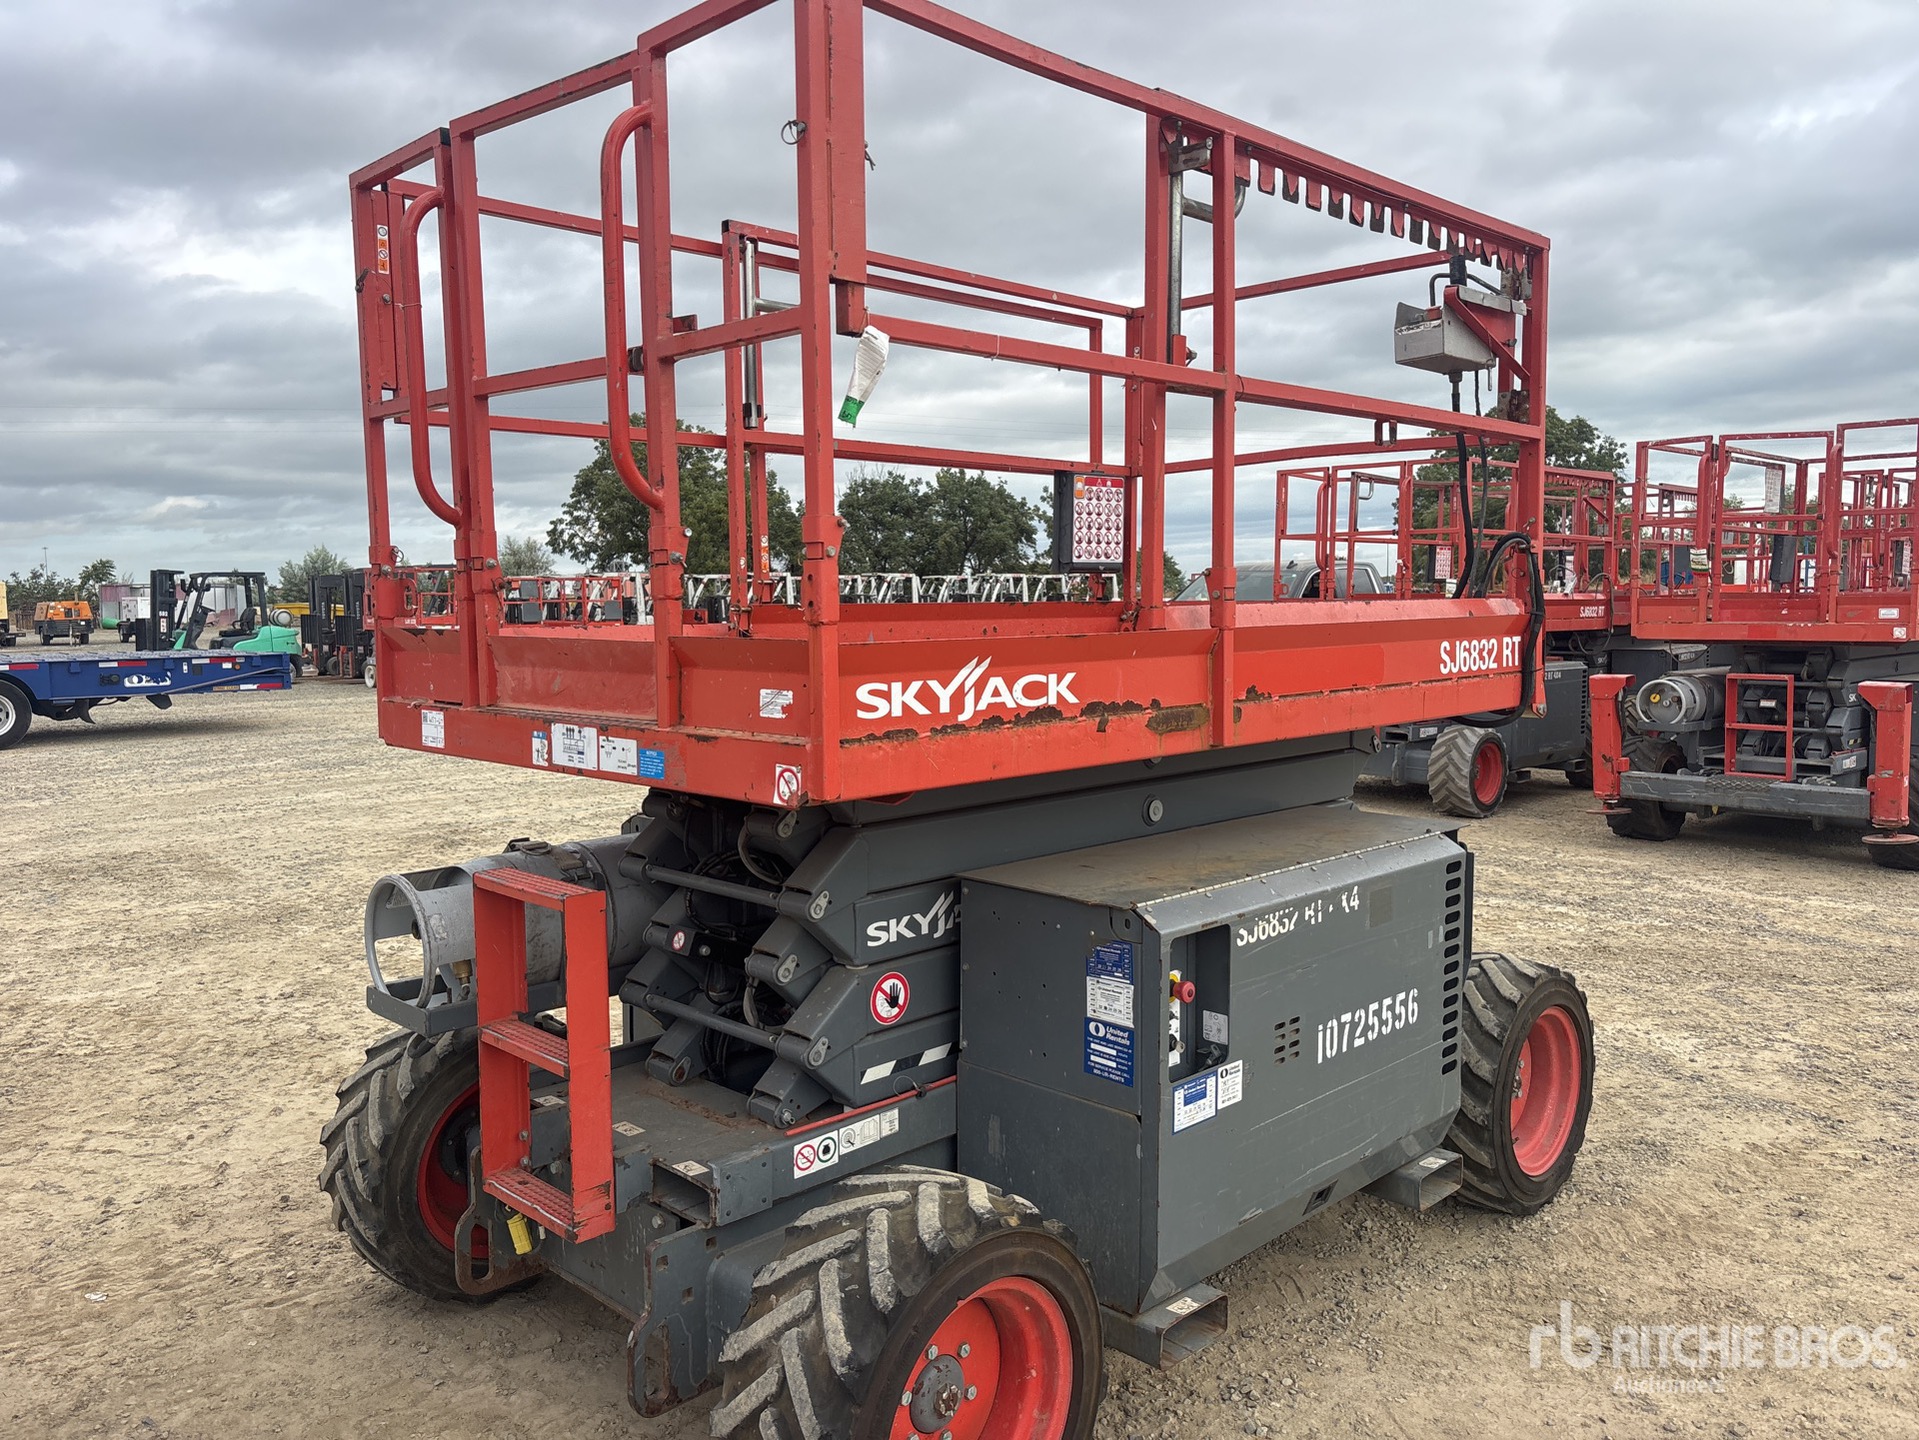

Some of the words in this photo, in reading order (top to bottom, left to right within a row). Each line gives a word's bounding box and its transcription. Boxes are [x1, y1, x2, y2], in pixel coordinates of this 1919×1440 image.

[1440, 638, 1498, 674] SJ6832
[1502, 636, 1521, 667] RT
[855, 655, 1081, 722] SKYJACK
[866, 890, 962, 948] SKYJA
[1105, 1032, 1130, 1046] Rentals
[1106, 1025, 1129, 1038] United
[1317, 988, 1419, 1064] 10725556
